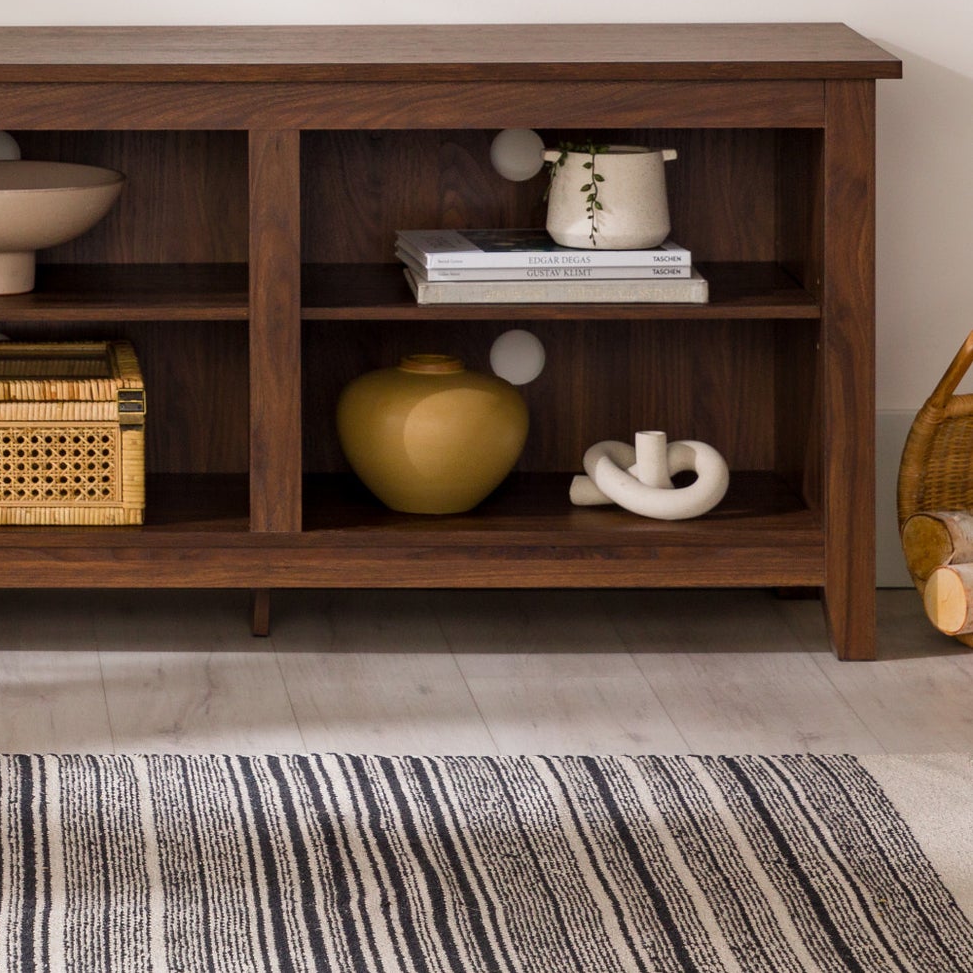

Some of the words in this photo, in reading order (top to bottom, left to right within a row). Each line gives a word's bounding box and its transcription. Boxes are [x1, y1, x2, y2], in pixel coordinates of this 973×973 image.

[528, 256, 559, 264] EDGAR
[562, 256, 591, 264] DEGAS
[526, 269, 560, 277] GUSTAV
[563, 269, 592, 277] KLIMT
